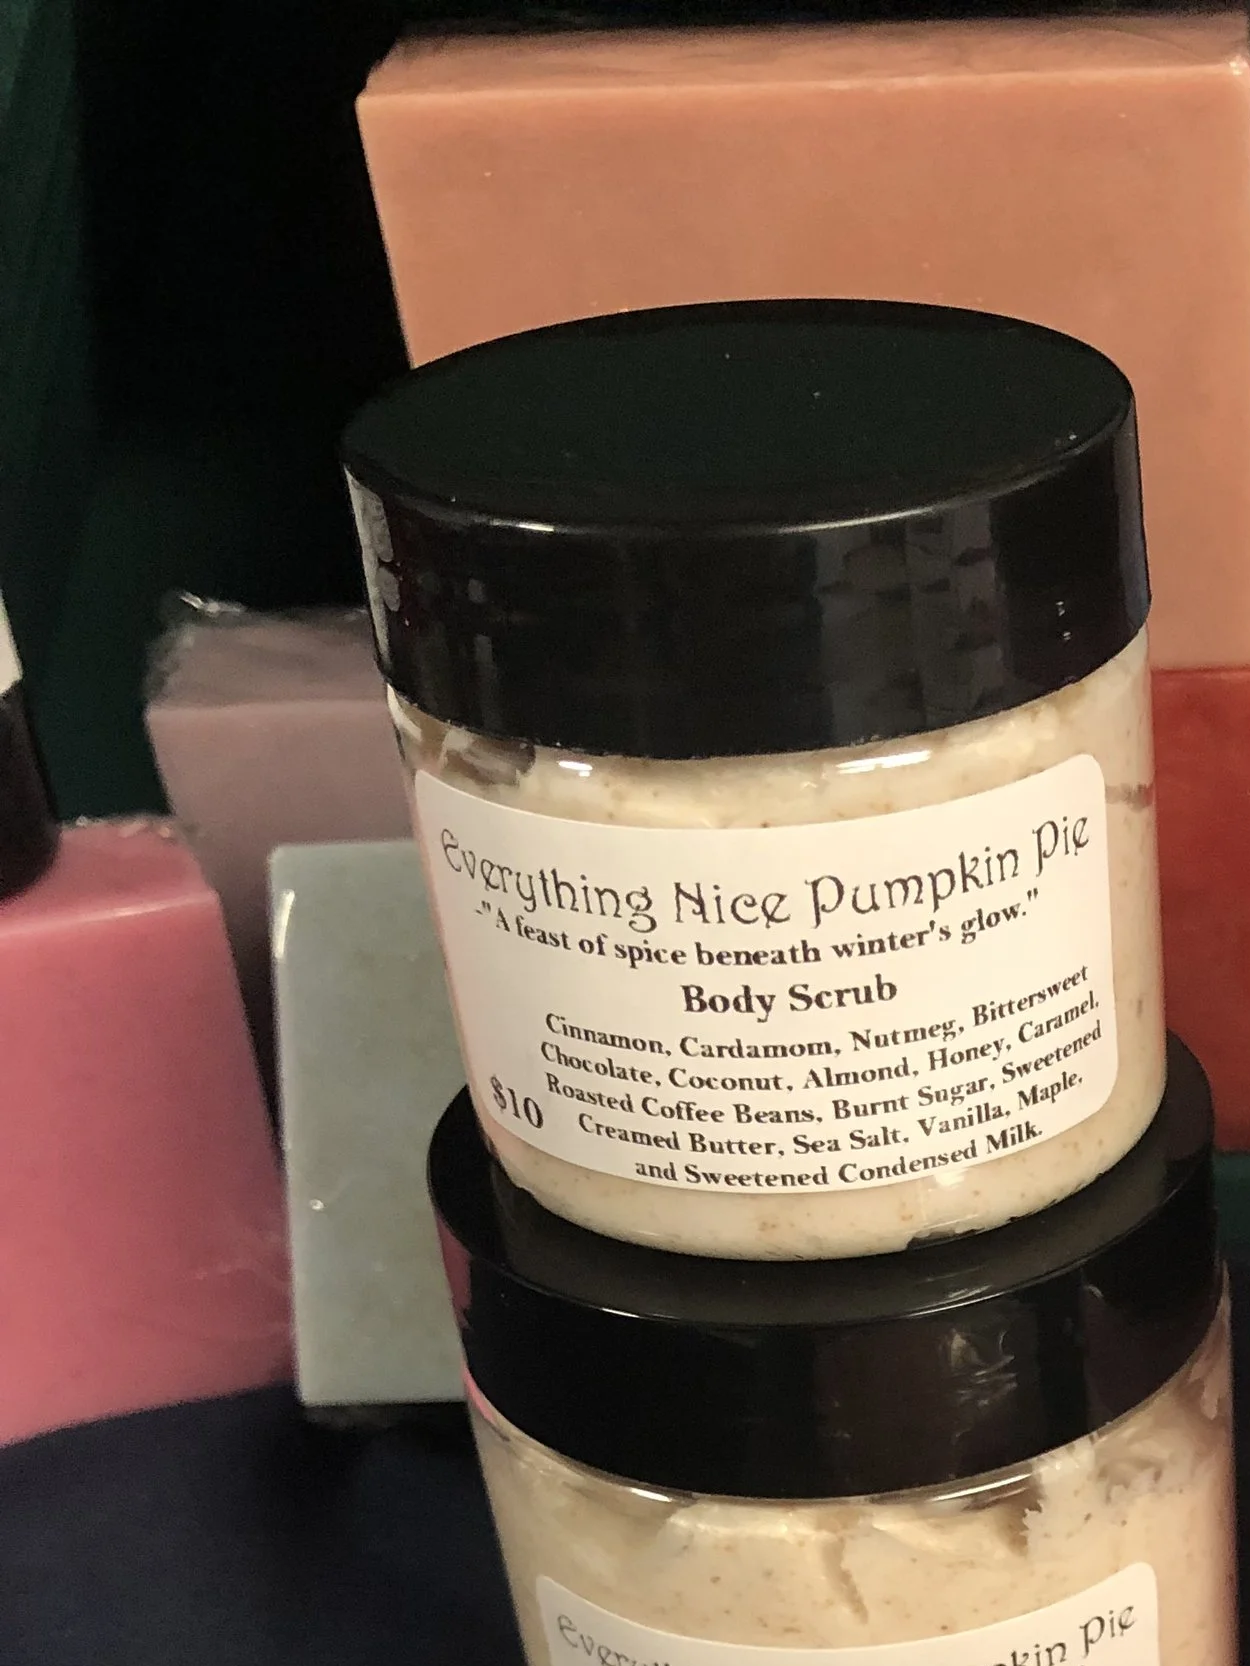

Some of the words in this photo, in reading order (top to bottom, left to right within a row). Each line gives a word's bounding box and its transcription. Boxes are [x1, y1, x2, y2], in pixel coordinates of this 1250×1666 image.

[441, 828, 658, 933] Everything
[674, 881, 790, 929] Nice
[804, 846, 1019, 929] Pumpkin
[1032, 816, 1090, 877] Pie
[516, 915, 571, 950] feast
[578, 933, 608, 956] of
[615, 940, 687, 970] spice
[694, 940, 821, 965] beneath
[830, 919, 951, 958] winter's
[960, 887, 1039, 945] glow."
[545, 1012, 672, 1057] Cinnamon,
[679, 1035, 841, 1059] Cardamom,
[849, 1019, 965, 1052] Nutmeg,
[971, 964, 1088, 1027] Bittersweet
[680, 984, 776, 1023] Body
[789, 973, 898, 1012] Scrub
[540, 1041, 662, 1088] Chocolate,
[668, 1067, 794, 1092] Coconut,
[802, 1056, 920, 1090] Almond,
[928, 1037, 1012, 1072] Honey,
[1017, 990, 1100, 1044] Caramel,
[545, 1071, 635, 1115] Roasted
[641, 1096, 726, 1124] Coffee
[731, 1103, 823, 1124] Beans,
[831, 1093, 910, 1120] Burnt
[917, 1076, 996, 1107] Sugar,
[1001, 1019, 1103, 1086] Sweetened
[490, 1074, 544, 1130] $10
[578, 1112, 681, 1152] Creamed
[687, 1132, 786, 1157] Butter,
[792, 1134, 842, 1156] Sea
[849, 1126, 910, 1151] Salt,
[916, 1102, 1012, 1139] Vanilla,
[1016, 1069, 1084, 1112] Maple,
[635, 1161, 678, 1182] and
[683, 1163, 829, 1187] Sweetened
[837, 1139, 978, 1184] Condensed
[985, 1119, 1044, 1156] Milk.
[1079, 1605, 1135, 1658] Pie
